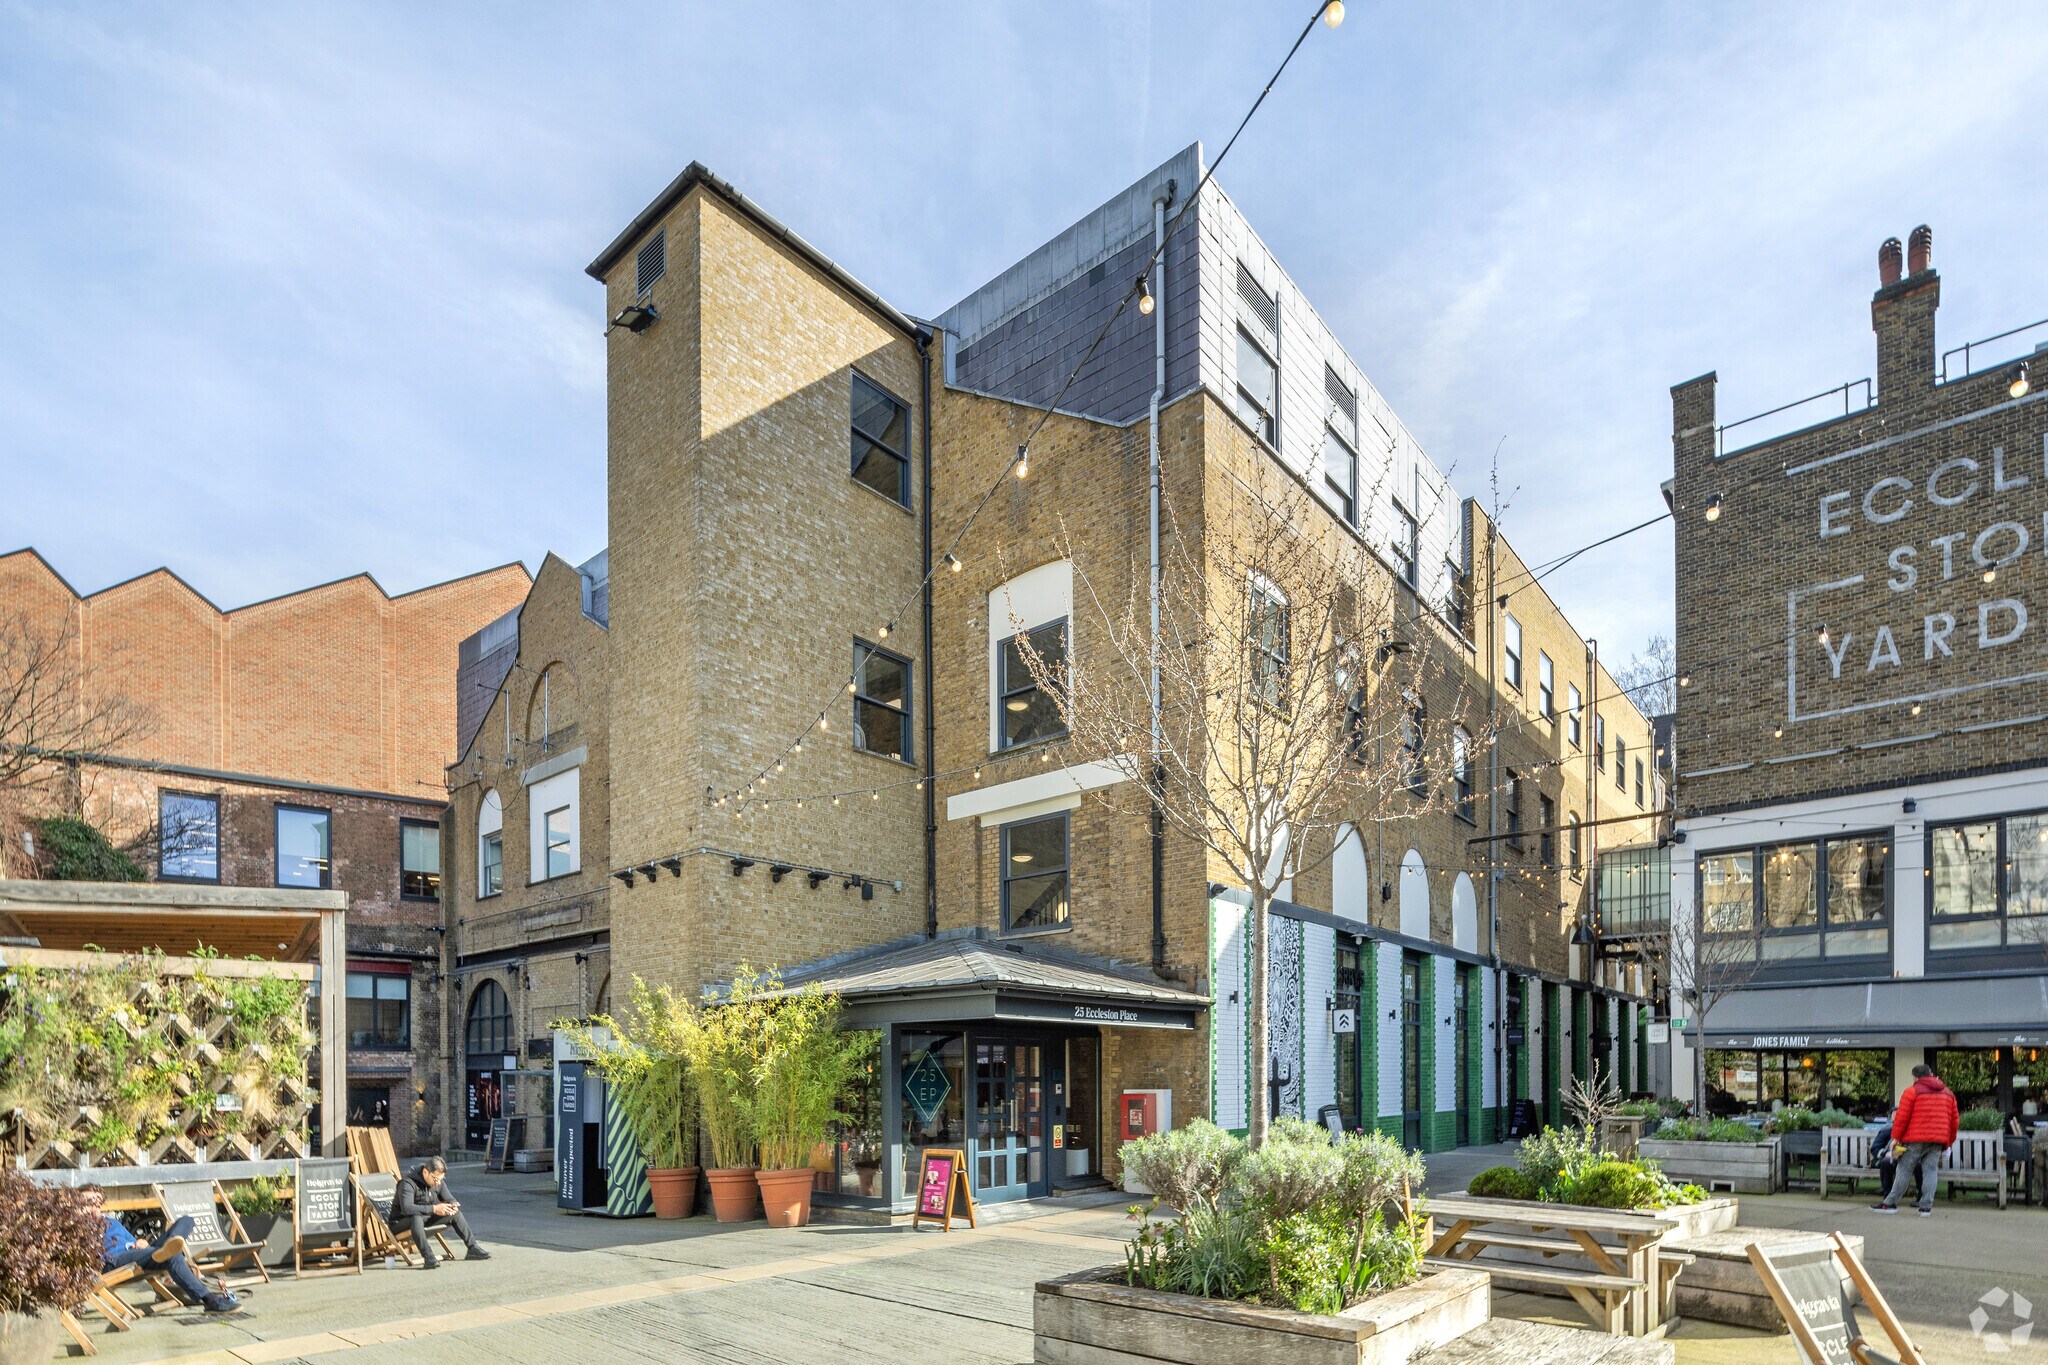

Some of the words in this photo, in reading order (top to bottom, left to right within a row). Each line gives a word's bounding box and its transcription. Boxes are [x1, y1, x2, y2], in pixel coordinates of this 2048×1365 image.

[1820, 433, 2048, 538] ECCL
[1887, 511, 2048, 592] STO
[1074, 1006, 1085, 1018] 25
[1085, 1007, 1119, 1020] Eccleston
[1120, 1010, 1138, 1021] Place
[1752, 1036, 1778, 1048] JONES
[1779, 1036, 1810, 1047] FAMILY
[920, 1068, 936, 1082] 25
[920, 1087, 937, 1101] EP
[310, 1193, 340, 1203] ECCLE
[318, 1202, 340, 1211] STON
[193, 1216, 212, 1226] CLE
[311, 1210, 340, 1219] YARDS
[1798, 1295, 1841, 1320] elgravia
[1818, 1336, 1849, 1357] CCLE
